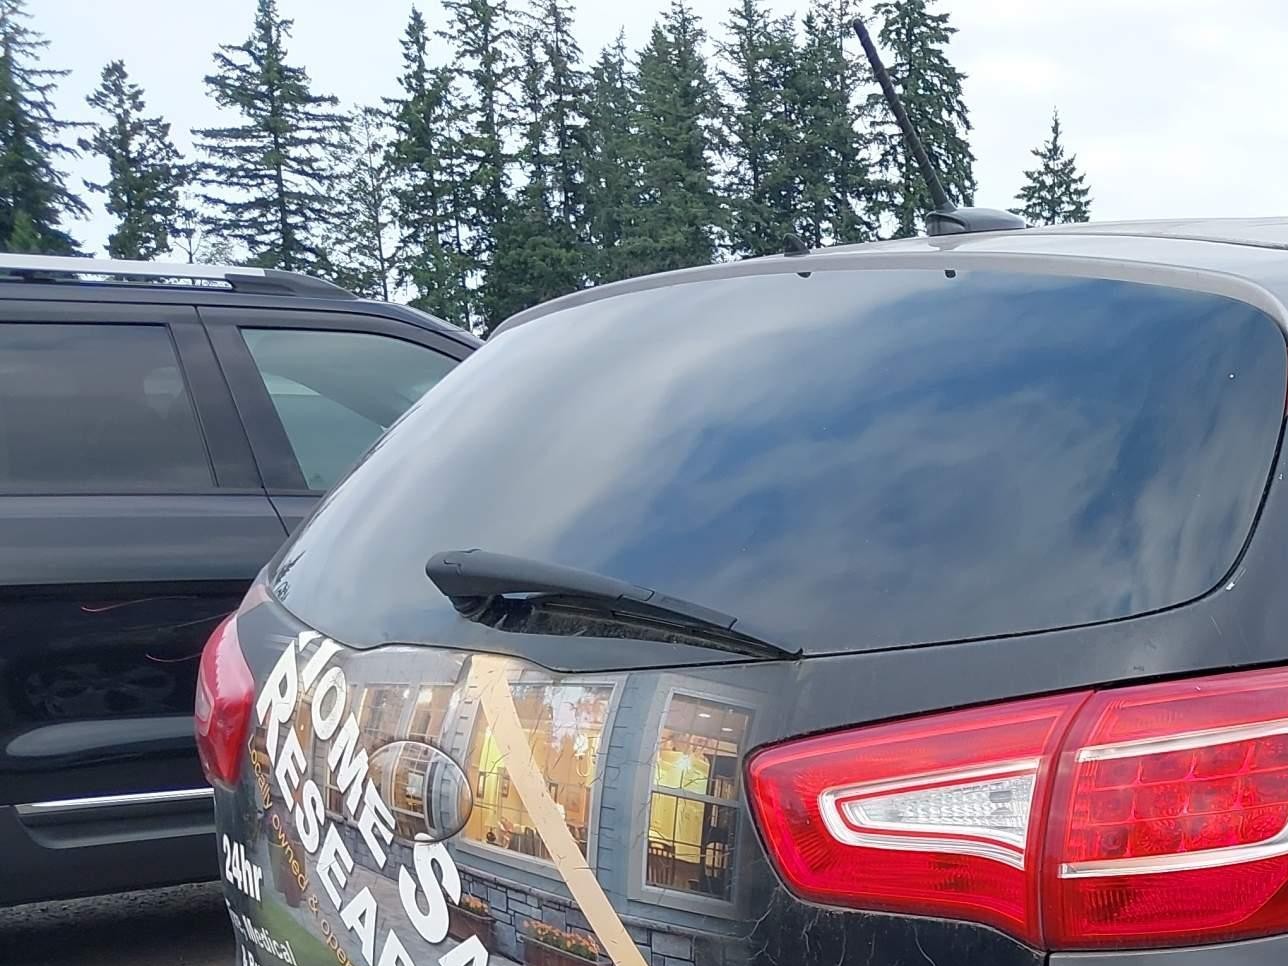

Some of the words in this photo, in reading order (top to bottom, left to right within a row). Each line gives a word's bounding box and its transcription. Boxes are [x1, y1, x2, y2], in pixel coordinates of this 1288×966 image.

[222, 833, 264, 902] 24hr
[247, 733, 274, 811] Locally
[271, 813, 309, 892] owned
[307, 894, 321, 917] &
